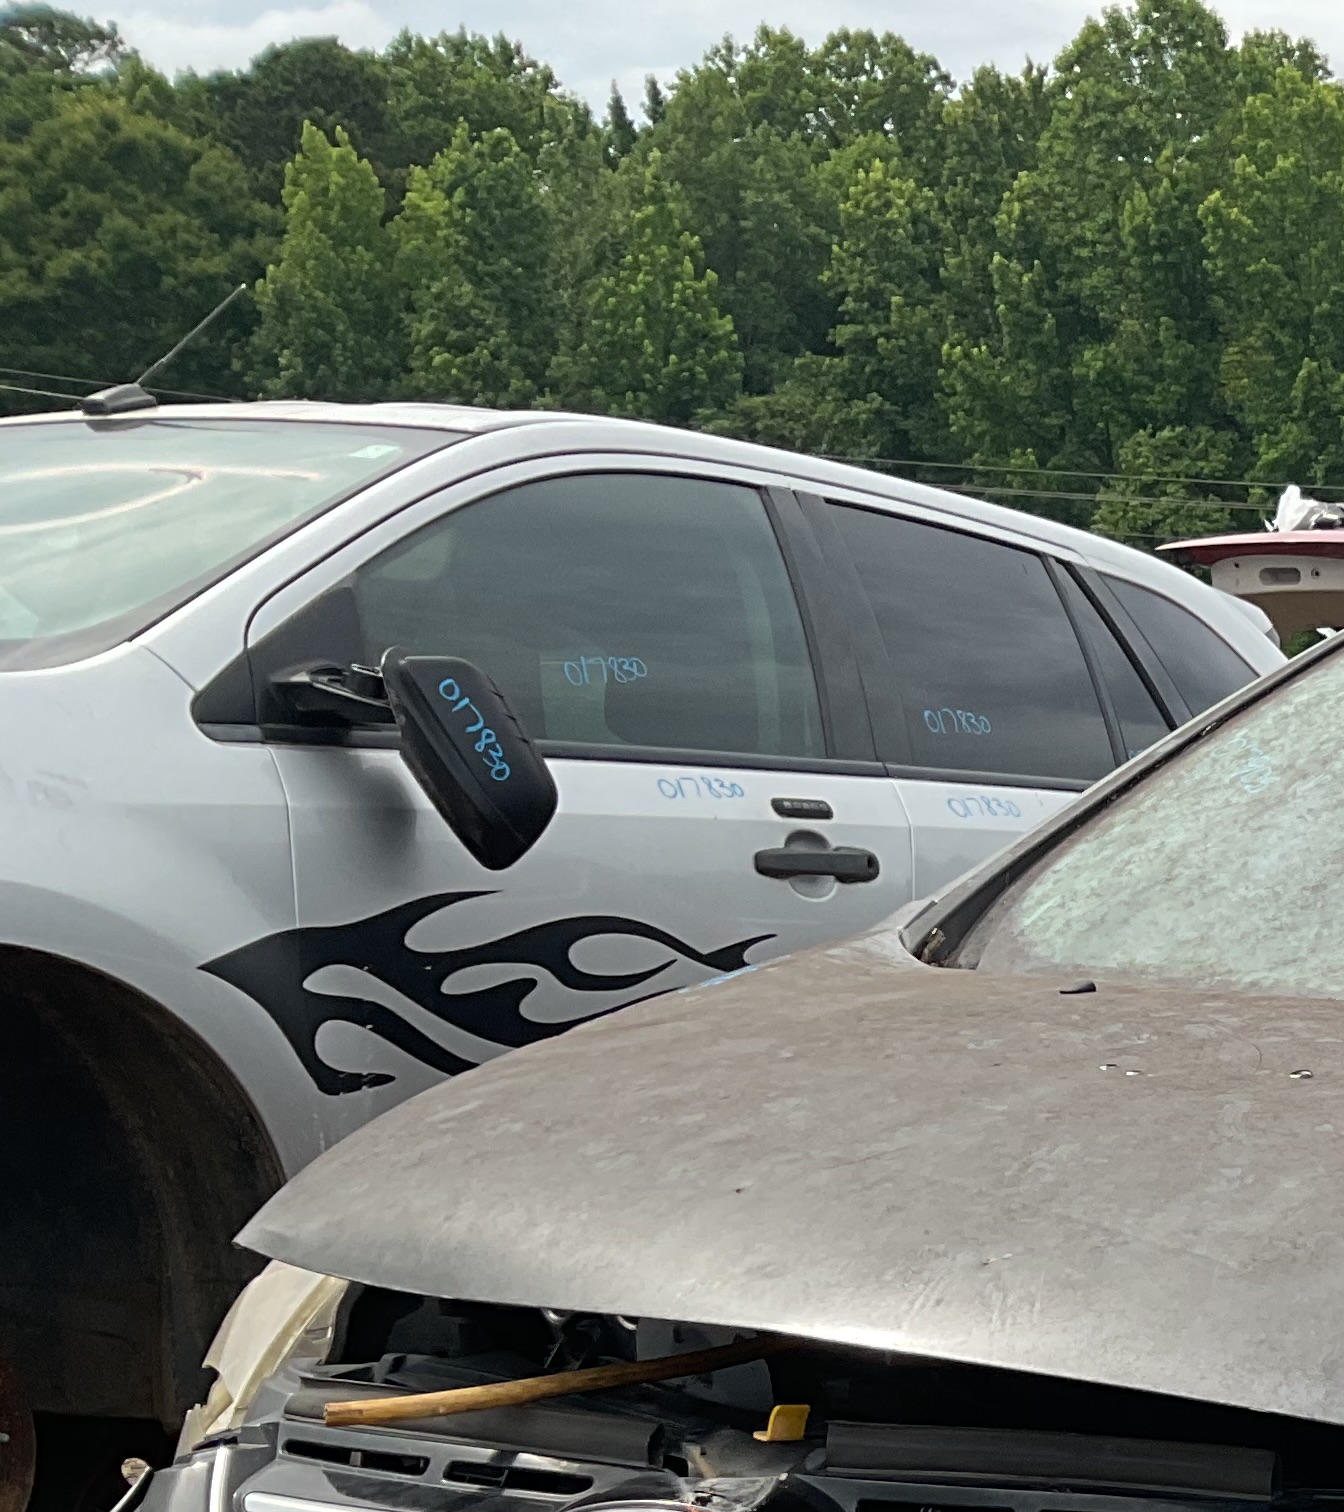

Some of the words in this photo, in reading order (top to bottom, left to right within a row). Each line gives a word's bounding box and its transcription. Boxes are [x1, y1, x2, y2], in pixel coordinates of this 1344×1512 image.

[563, 656, 648, 687] 017830
[438, 678, 511, 781] 017830
[924, 708, 992, 735] 017830
[657, 776, 745, 799] 017830
[947, 795, 1022, 818] 017830
